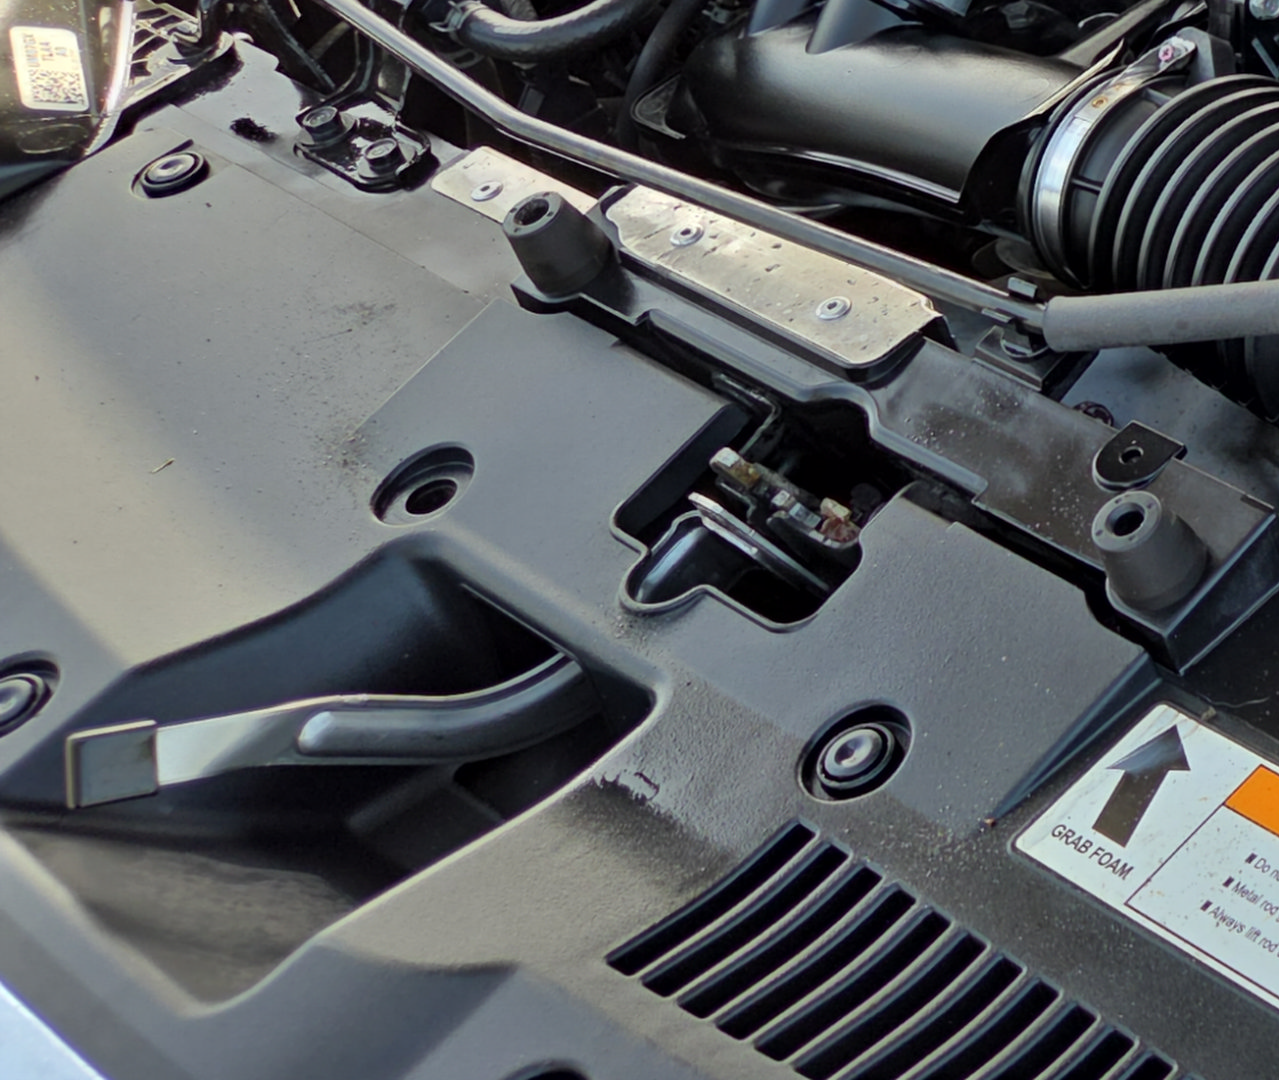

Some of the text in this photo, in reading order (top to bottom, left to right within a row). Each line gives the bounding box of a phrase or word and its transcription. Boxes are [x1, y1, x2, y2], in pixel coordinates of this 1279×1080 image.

[1051, 824, 1134, 880] GRAB FOAM
[1254, 858, 1271, 873] Do
[1231, 881, 1264, 904] Metal
[1208, 905, 1246, 934] Always
[1245, 926, 1262, 942] lift
